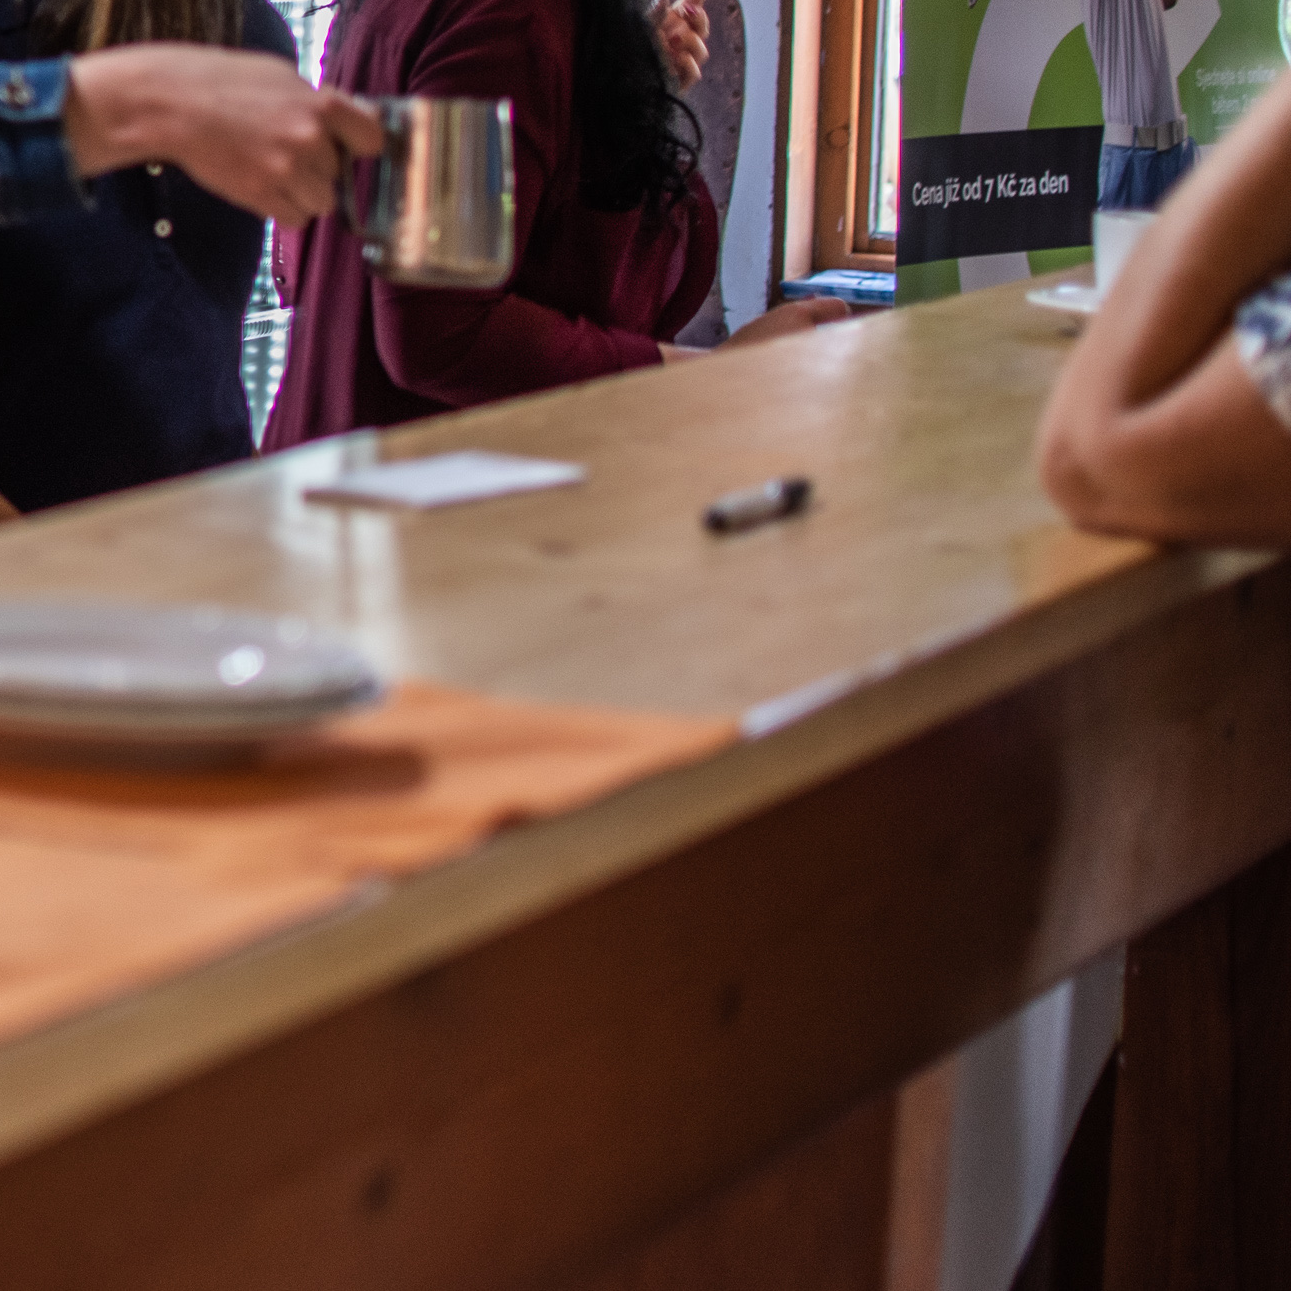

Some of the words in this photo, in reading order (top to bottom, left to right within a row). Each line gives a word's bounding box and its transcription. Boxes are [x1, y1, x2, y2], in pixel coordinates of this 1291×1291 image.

[912, 181, 944, 207] Cena
[943, 177, 961, 209] již
[962, 174, 982, 201] od
[984, 178, 995, 204] 7
[997, 172, 1017, 199] Kč
[1019, 176, 1037, 197] za
[1039, 168, 1070, 196] den
